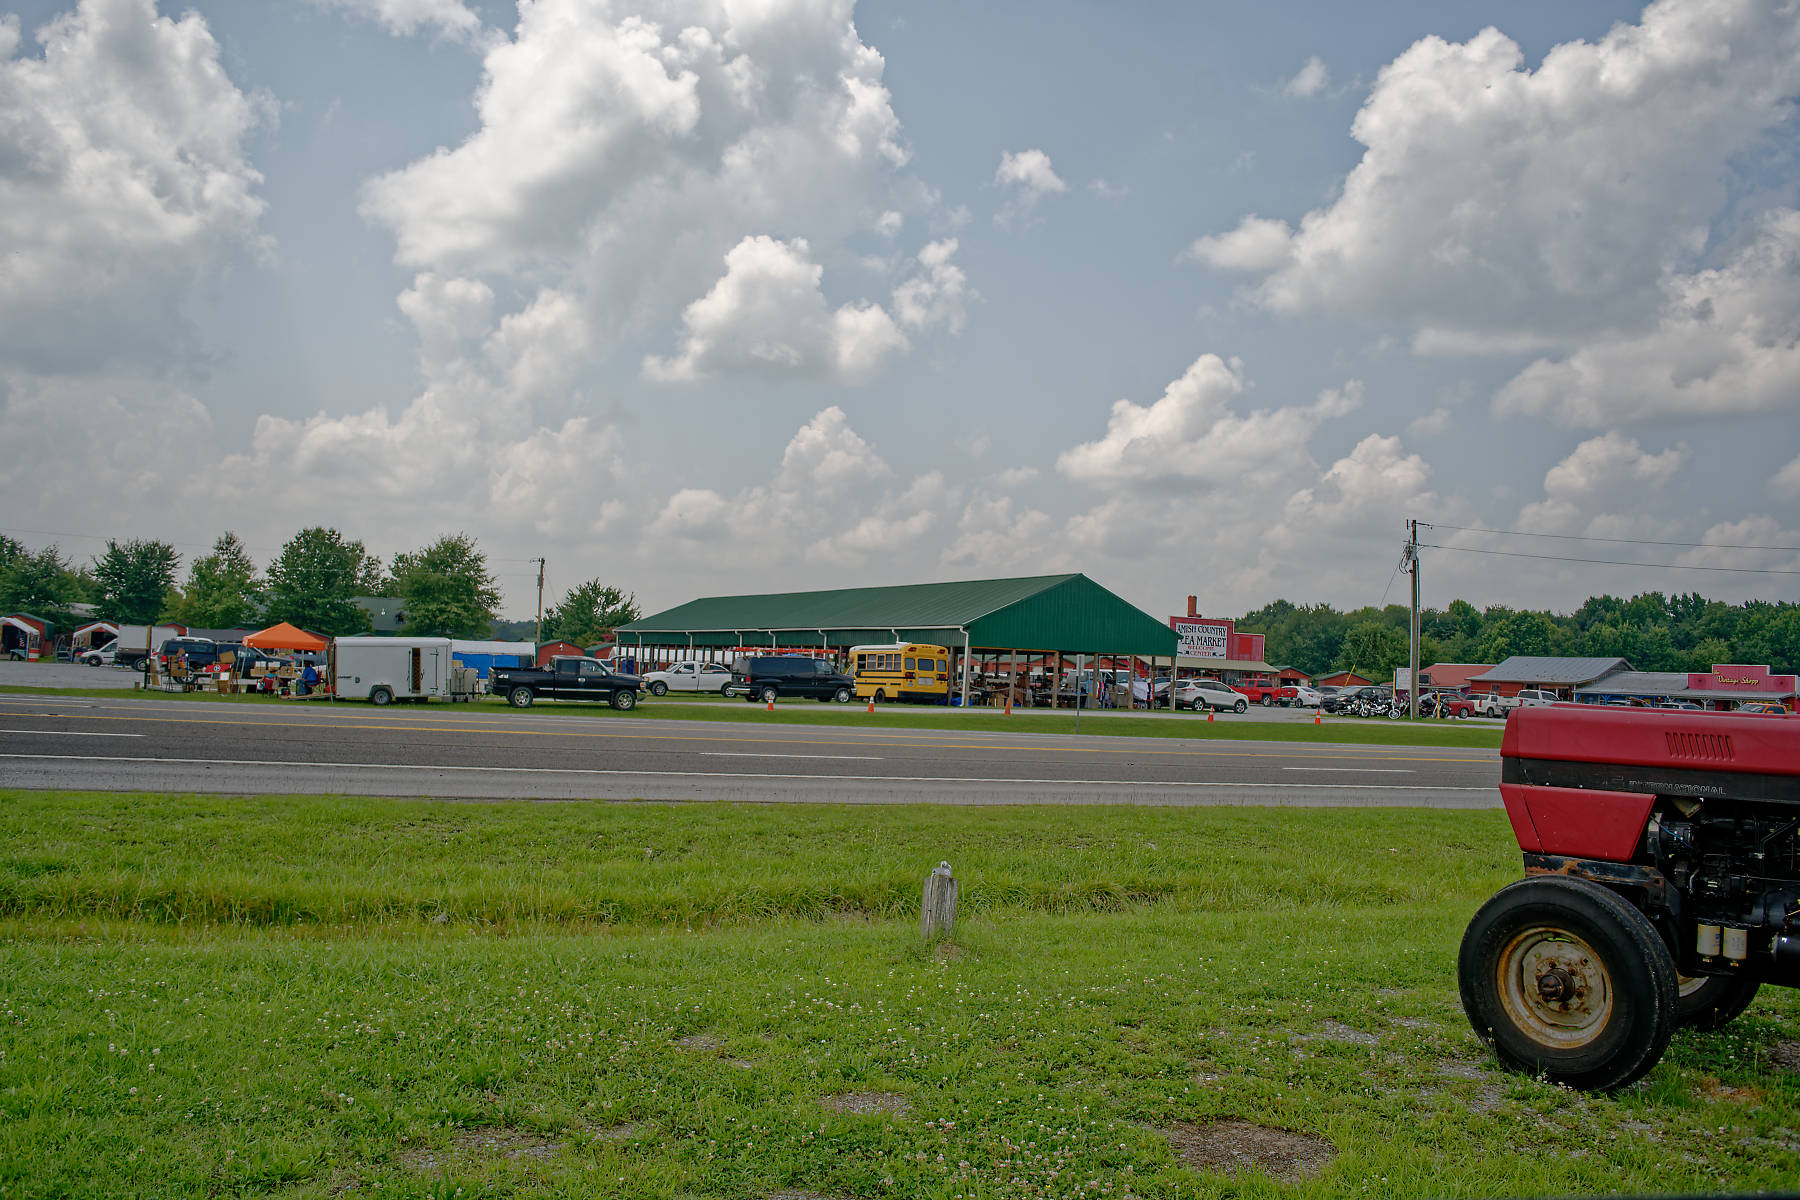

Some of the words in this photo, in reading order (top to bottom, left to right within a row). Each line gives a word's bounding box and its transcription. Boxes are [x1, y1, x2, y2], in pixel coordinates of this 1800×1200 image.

[1177, 624, 1197, 633] AMISH
[1197, 625, 1227, 637] COUNTRY
[1197, 636, 1227, 648] MARKET
